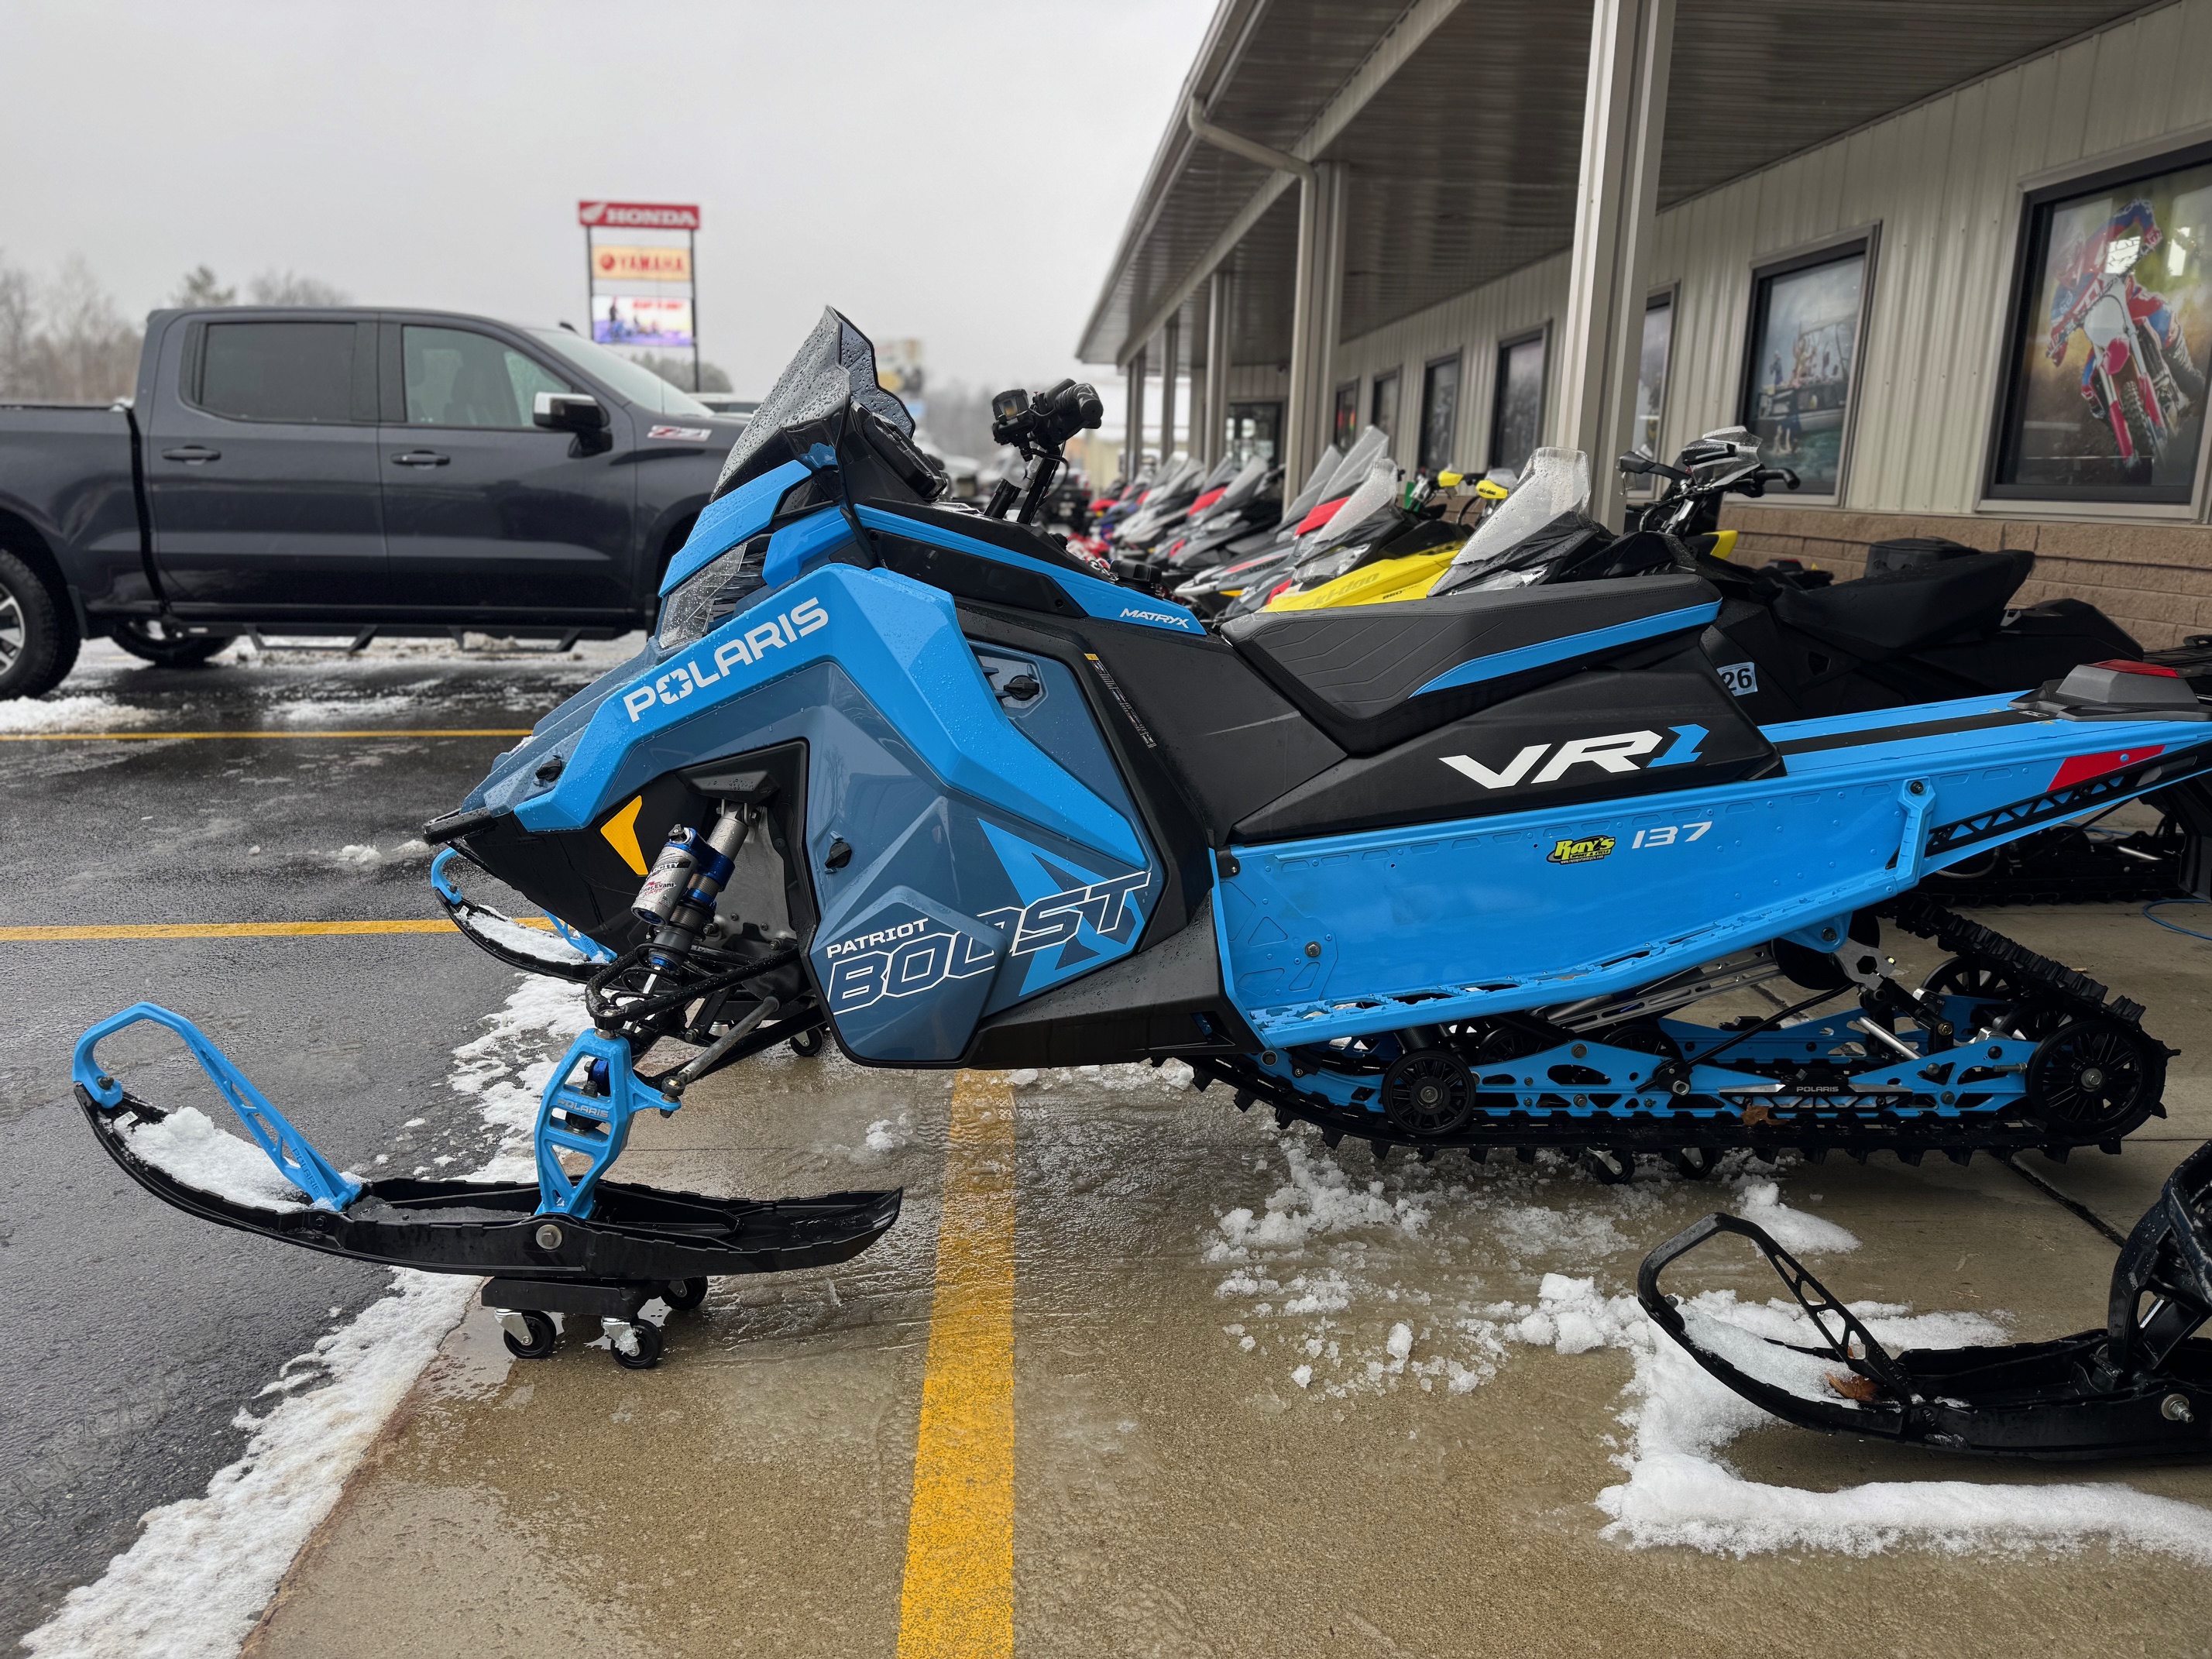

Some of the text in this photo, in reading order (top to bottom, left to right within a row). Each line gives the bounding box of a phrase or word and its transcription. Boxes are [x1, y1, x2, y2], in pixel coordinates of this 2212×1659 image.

[606, 208, 696, 226] HONDA
[621, 255, 684, 272] YAMAHA
[1119, 608, 1190, 629] MATRYX
[623, 596, 829, 723] POLARIS
[1721, 668, 1753, 690] 26
[1439, 723, 1710, 789] VR1
[1631, 821, 1712, 849] 137
[826, 917, 929, 959] PATRIOT
[827, 871, 1151, 1015] BOOST
[558, 1098, 609, 1118] POLARIS
[293, 1148, 321, 1194] POLARIS
